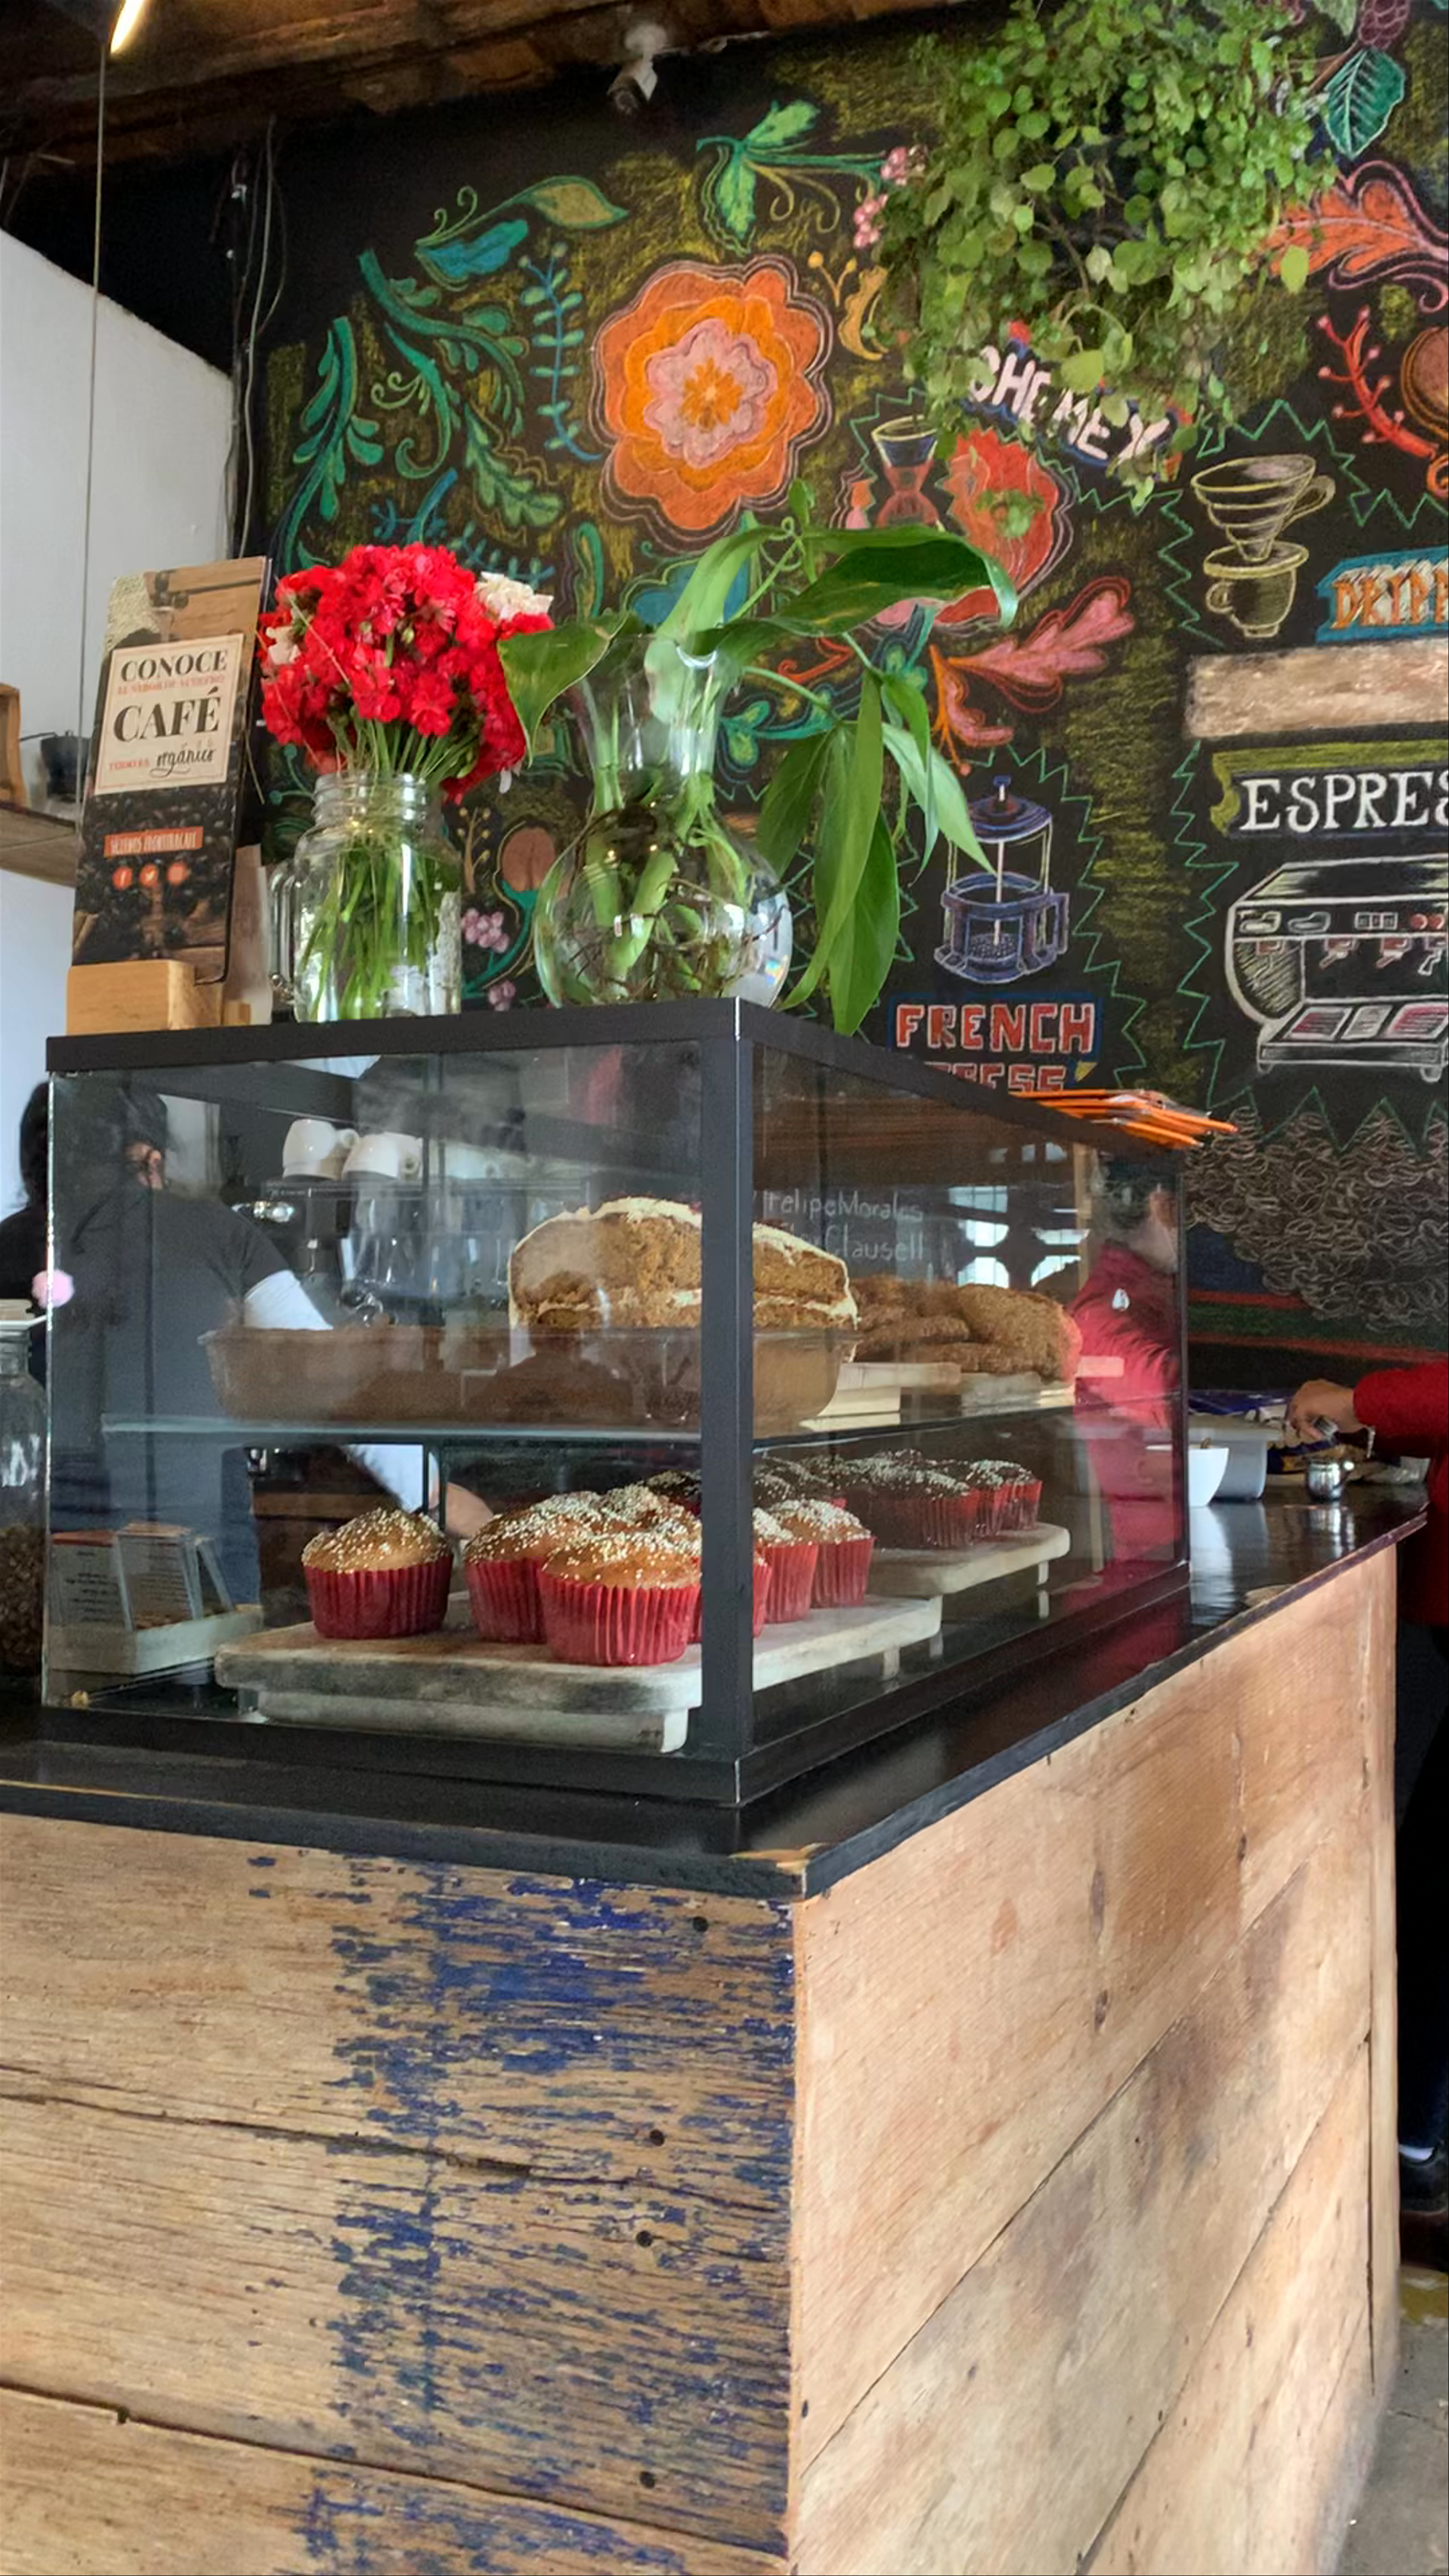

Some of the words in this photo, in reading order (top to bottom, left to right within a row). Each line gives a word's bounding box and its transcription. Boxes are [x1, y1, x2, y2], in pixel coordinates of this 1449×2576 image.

[121, 650, 228, 681] CONOCE
[114, 686, 221, 742] CAFÉ
[896, 1003, 1095, 1053] FRENCH
